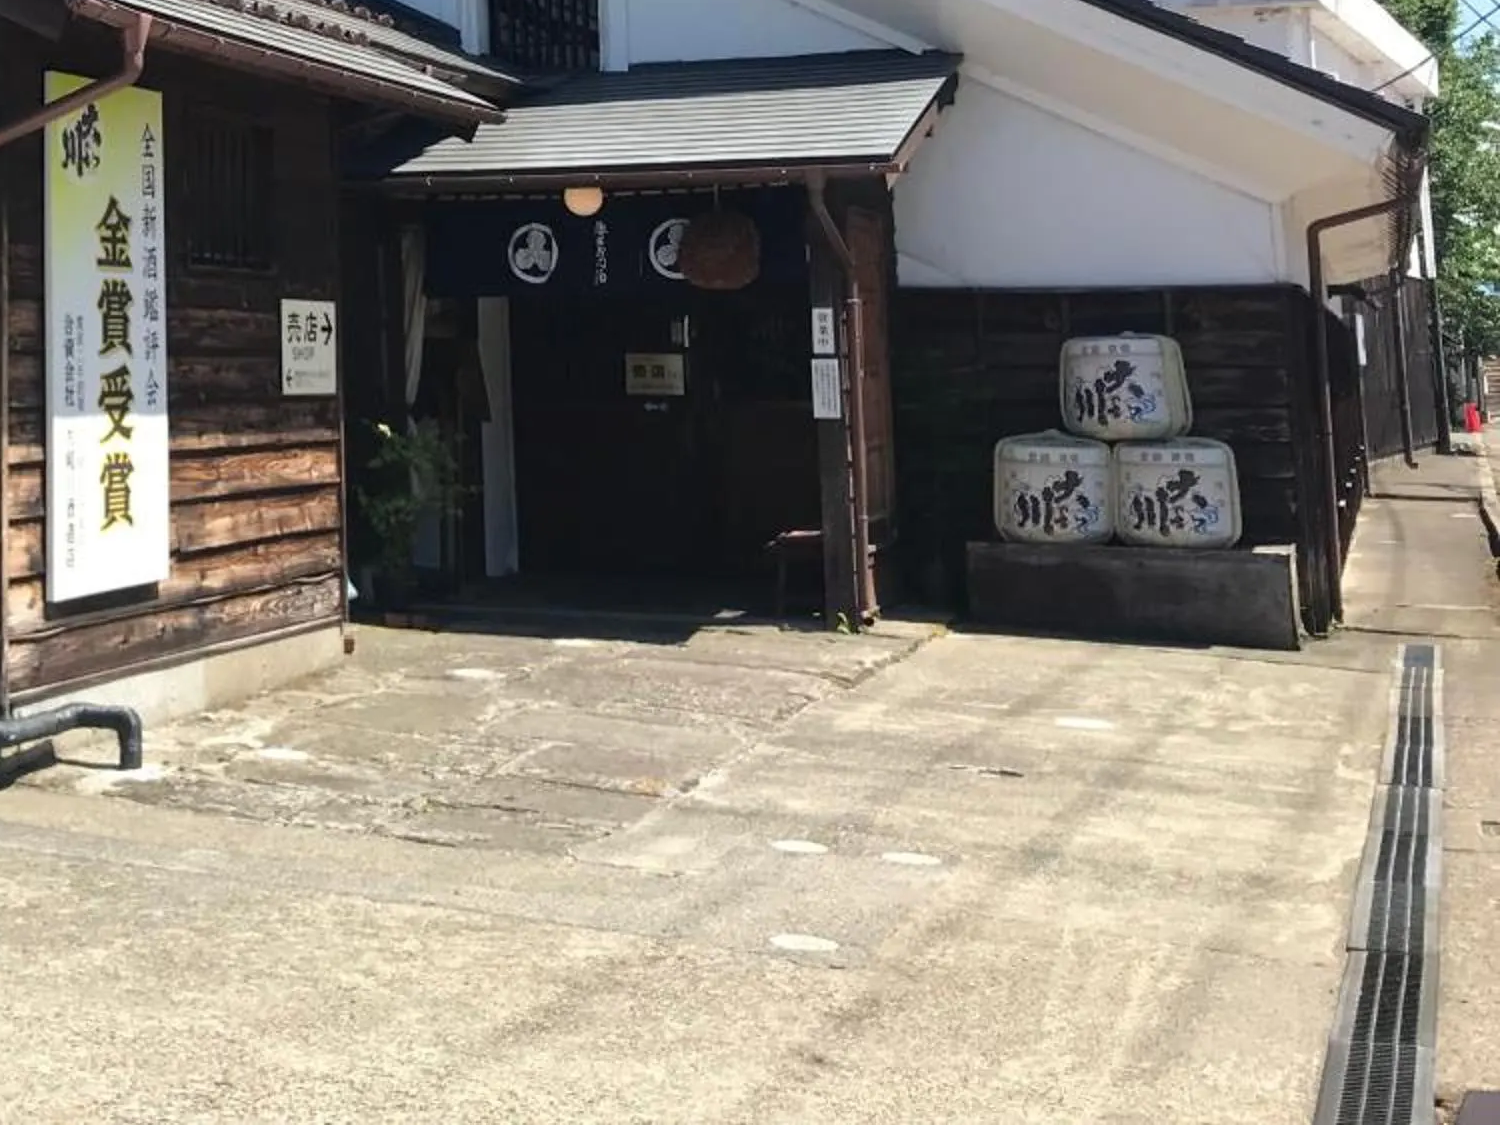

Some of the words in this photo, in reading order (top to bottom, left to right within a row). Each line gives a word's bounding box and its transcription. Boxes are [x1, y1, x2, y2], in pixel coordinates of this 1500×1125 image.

[95, 193, 134, 532] 金賞受賞
[286, 311, 318, 344] 売店
